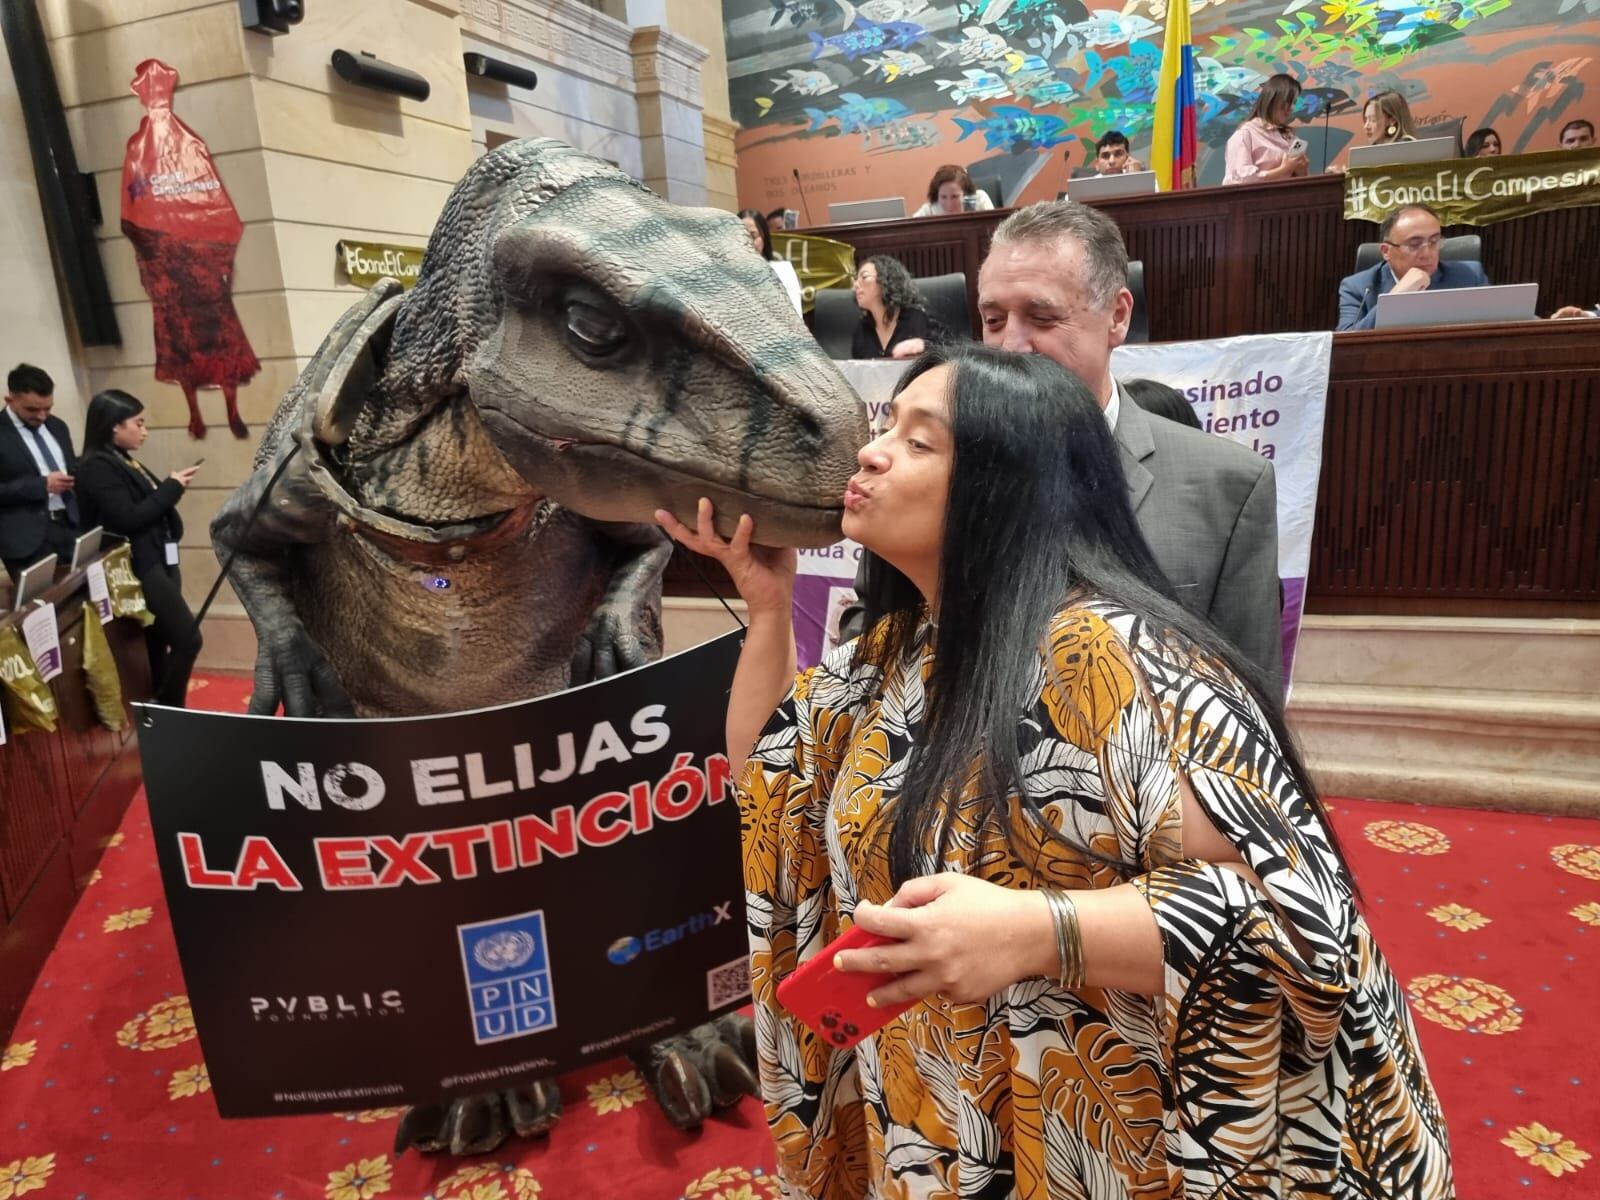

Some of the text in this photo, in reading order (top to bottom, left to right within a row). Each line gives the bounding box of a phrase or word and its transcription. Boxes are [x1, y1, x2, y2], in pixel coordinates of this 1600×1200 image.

[1199, 408, 1280, 434] iento
[260, 704, 671, 811] NO ELIJAS
[177, 832, 303, 891] LA
[645, 900, 732, 952] EarthX
